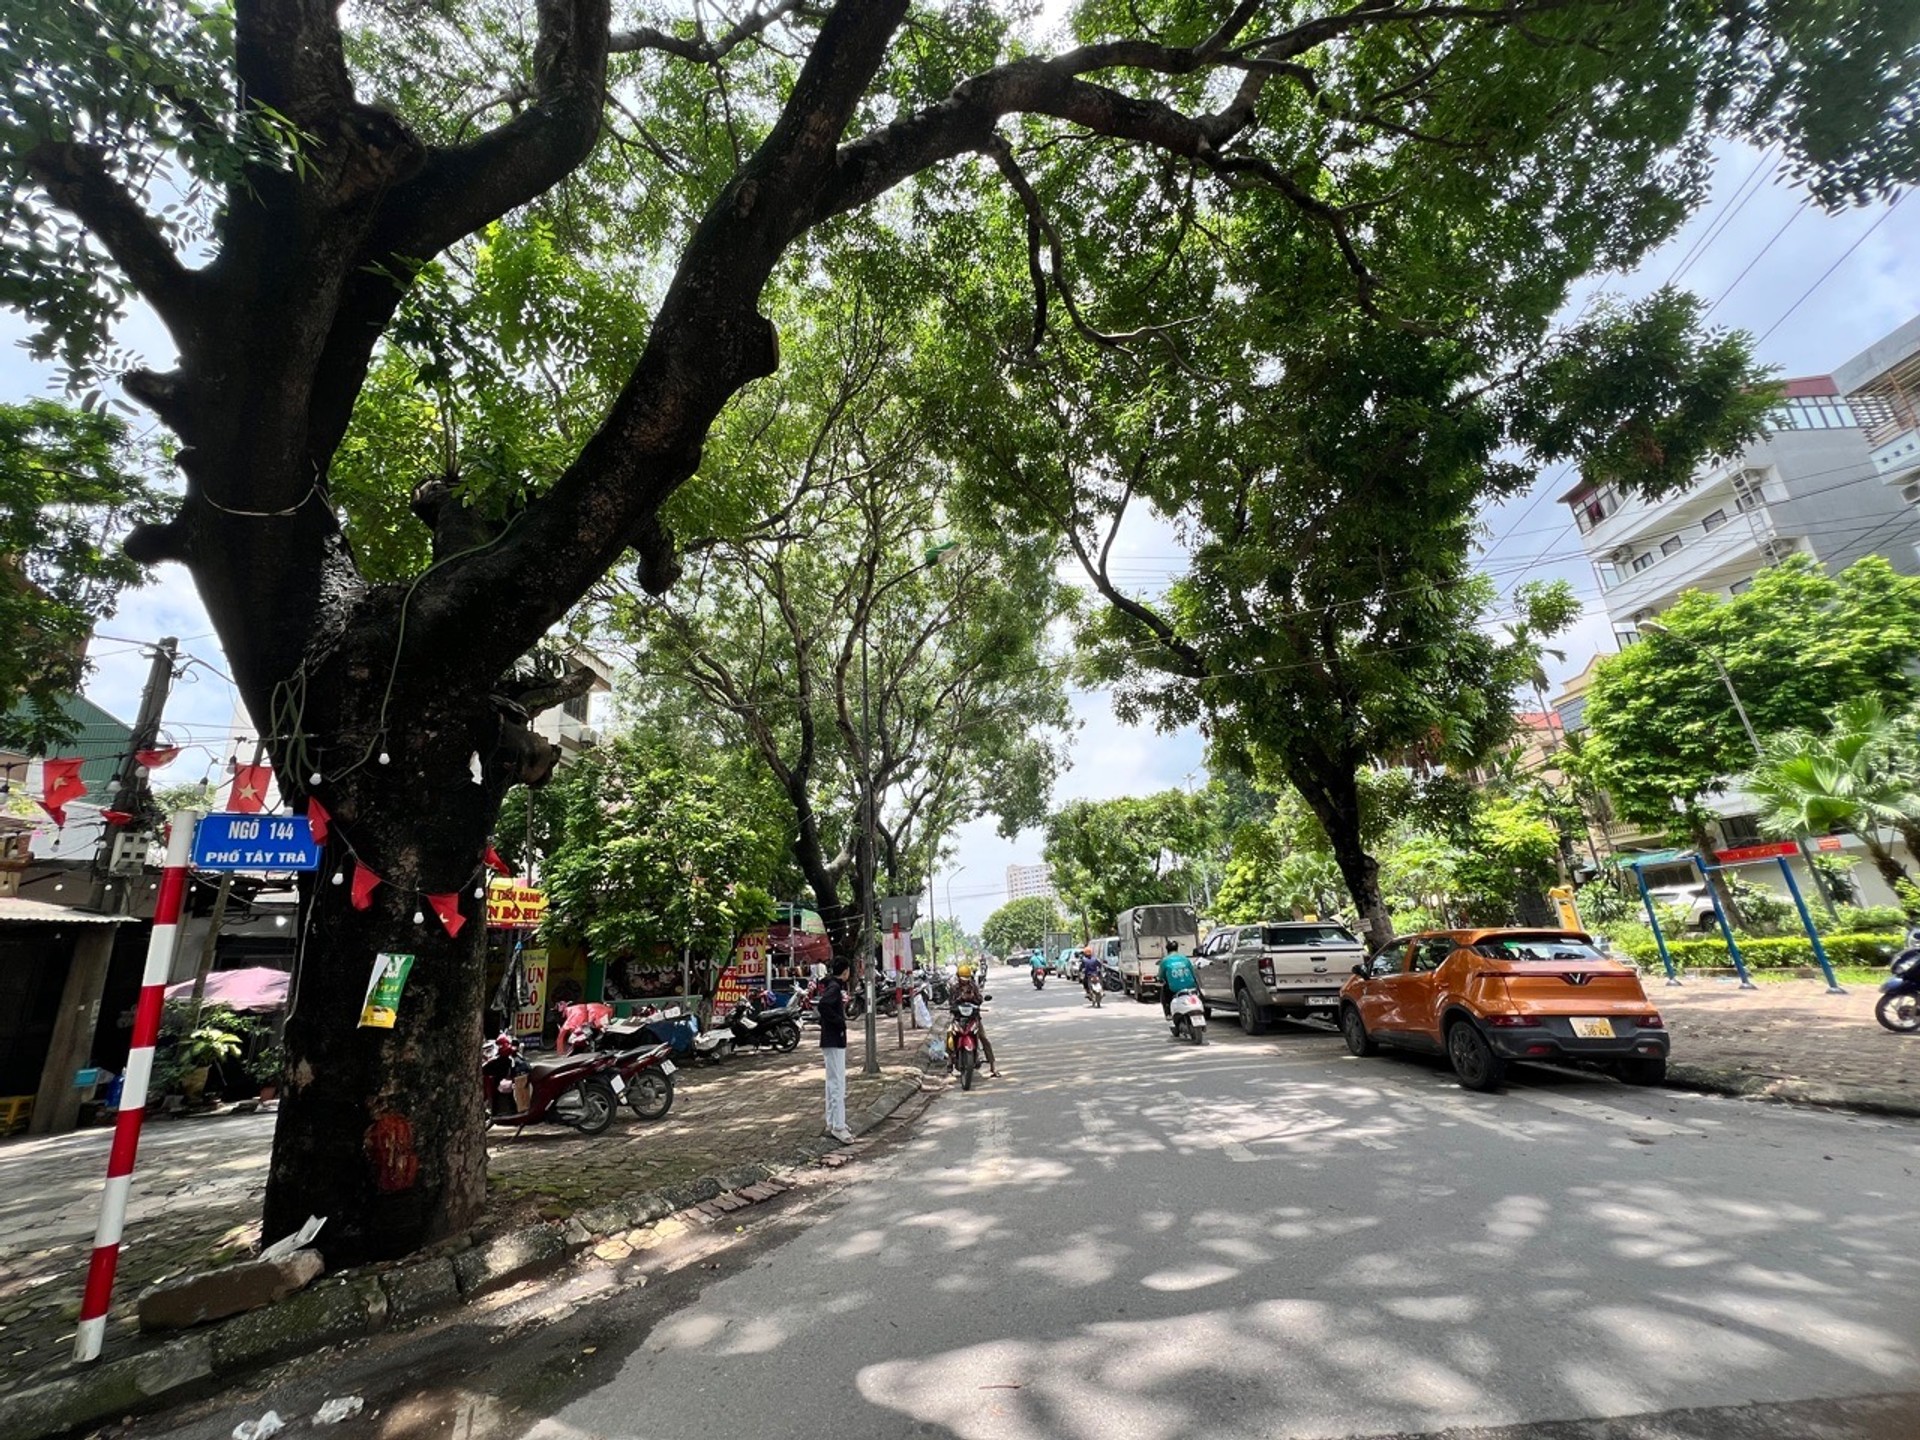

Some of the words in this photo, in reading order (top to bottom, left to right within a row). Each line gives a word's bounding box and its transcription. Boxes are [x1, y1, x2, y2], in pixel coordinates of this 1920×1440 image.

[228, 818, 260, 840] NGÕ
[269, 821, 295, 840] 144
[205, 848, 242, 863] PHỐ
[245, 849, 274, 863] TÂY
[278, 850, 307, 863] TRÀ
[523, 907, 541, 920] HU
[527, 963, 546, 984] ÚN
[515, 1005, 543, 1030] HUẾ
